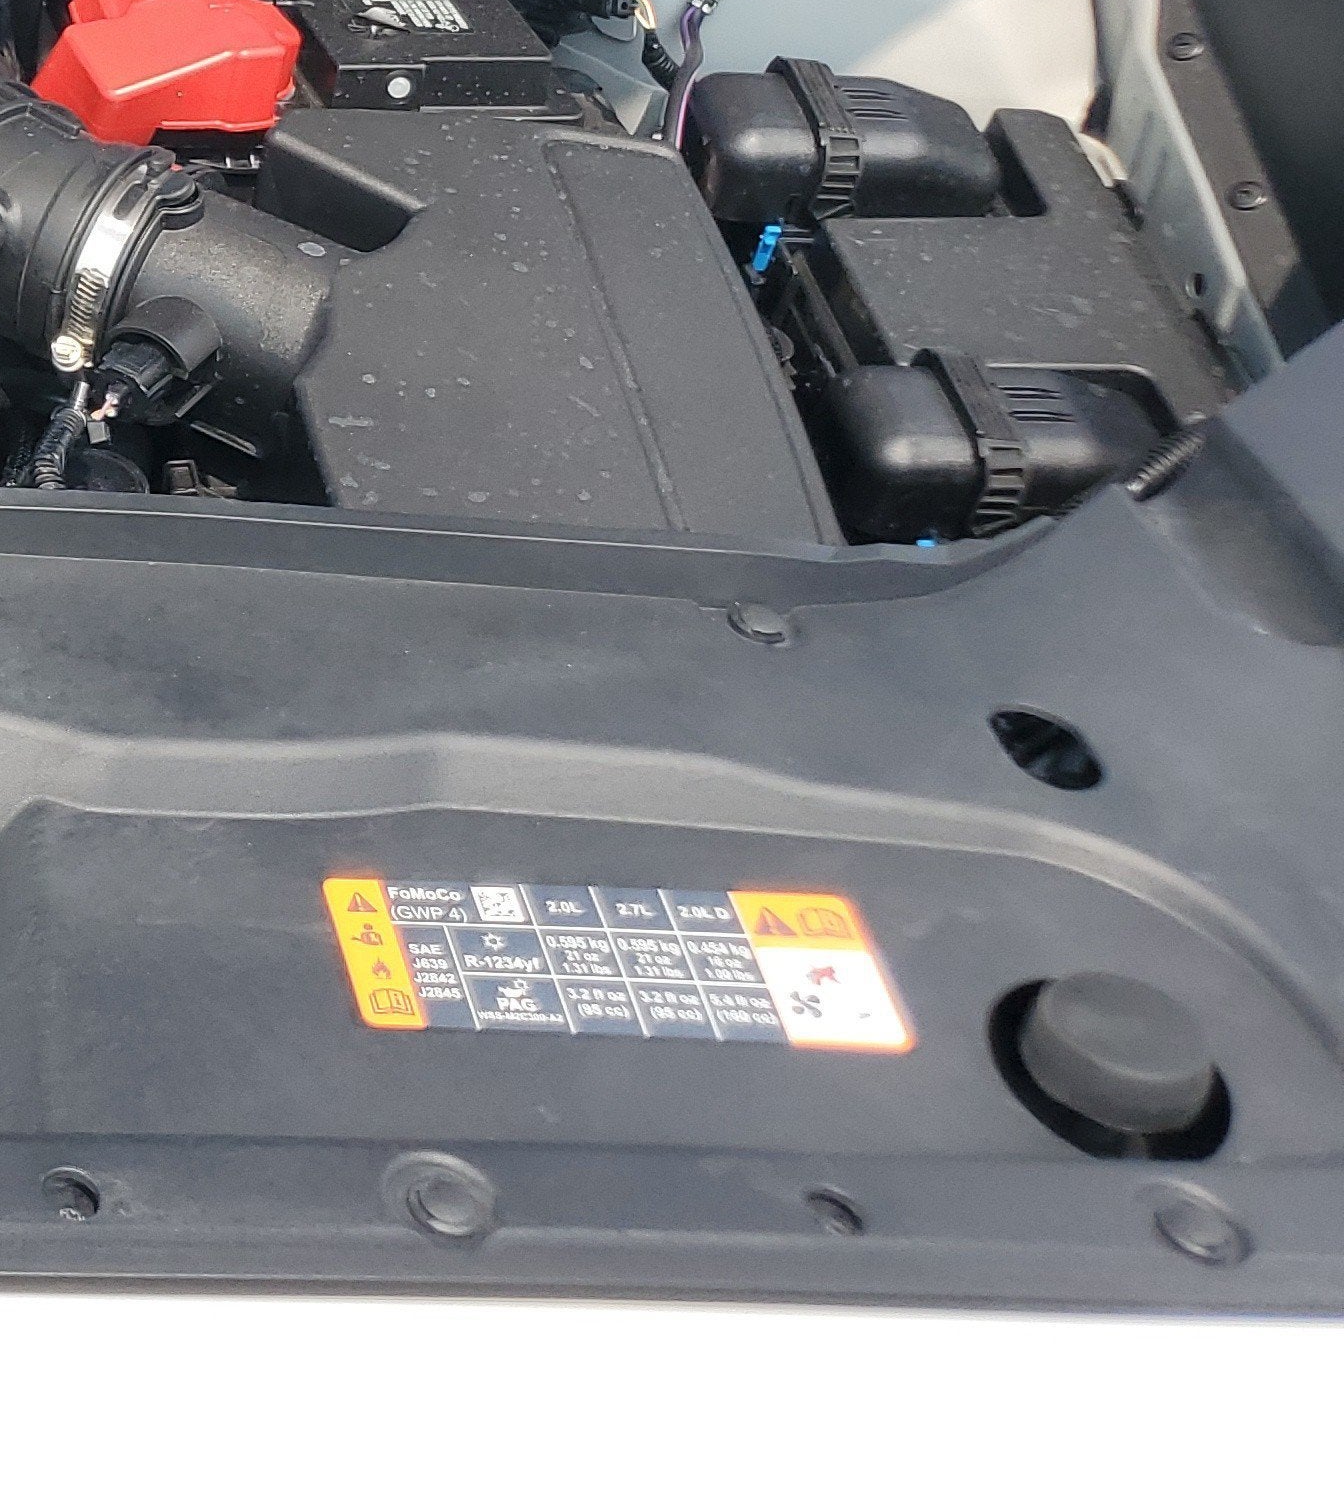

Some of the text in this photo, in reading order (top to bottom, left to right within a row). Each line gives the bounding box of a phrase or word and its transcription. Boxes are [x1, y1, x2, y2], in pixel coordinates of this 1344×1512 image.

[387, 886, 461, 902] FoMoCo
[390, 904, 468, 923] (GWP 4)
[545, 899, 585, 916] 2.0L
[615, 902, 655, 918] 2.7L
[676, 904, 713, 919] 2.0L
[408, 943, 443, 955] SAE
[588, 936, 611, 953] kg
[412, 958, 449, 970] J639
[463, 954, 541, 973] R-1234yf
[413, 972, 458, 984] J2842
[496, 997, 539, 1012] PAG
